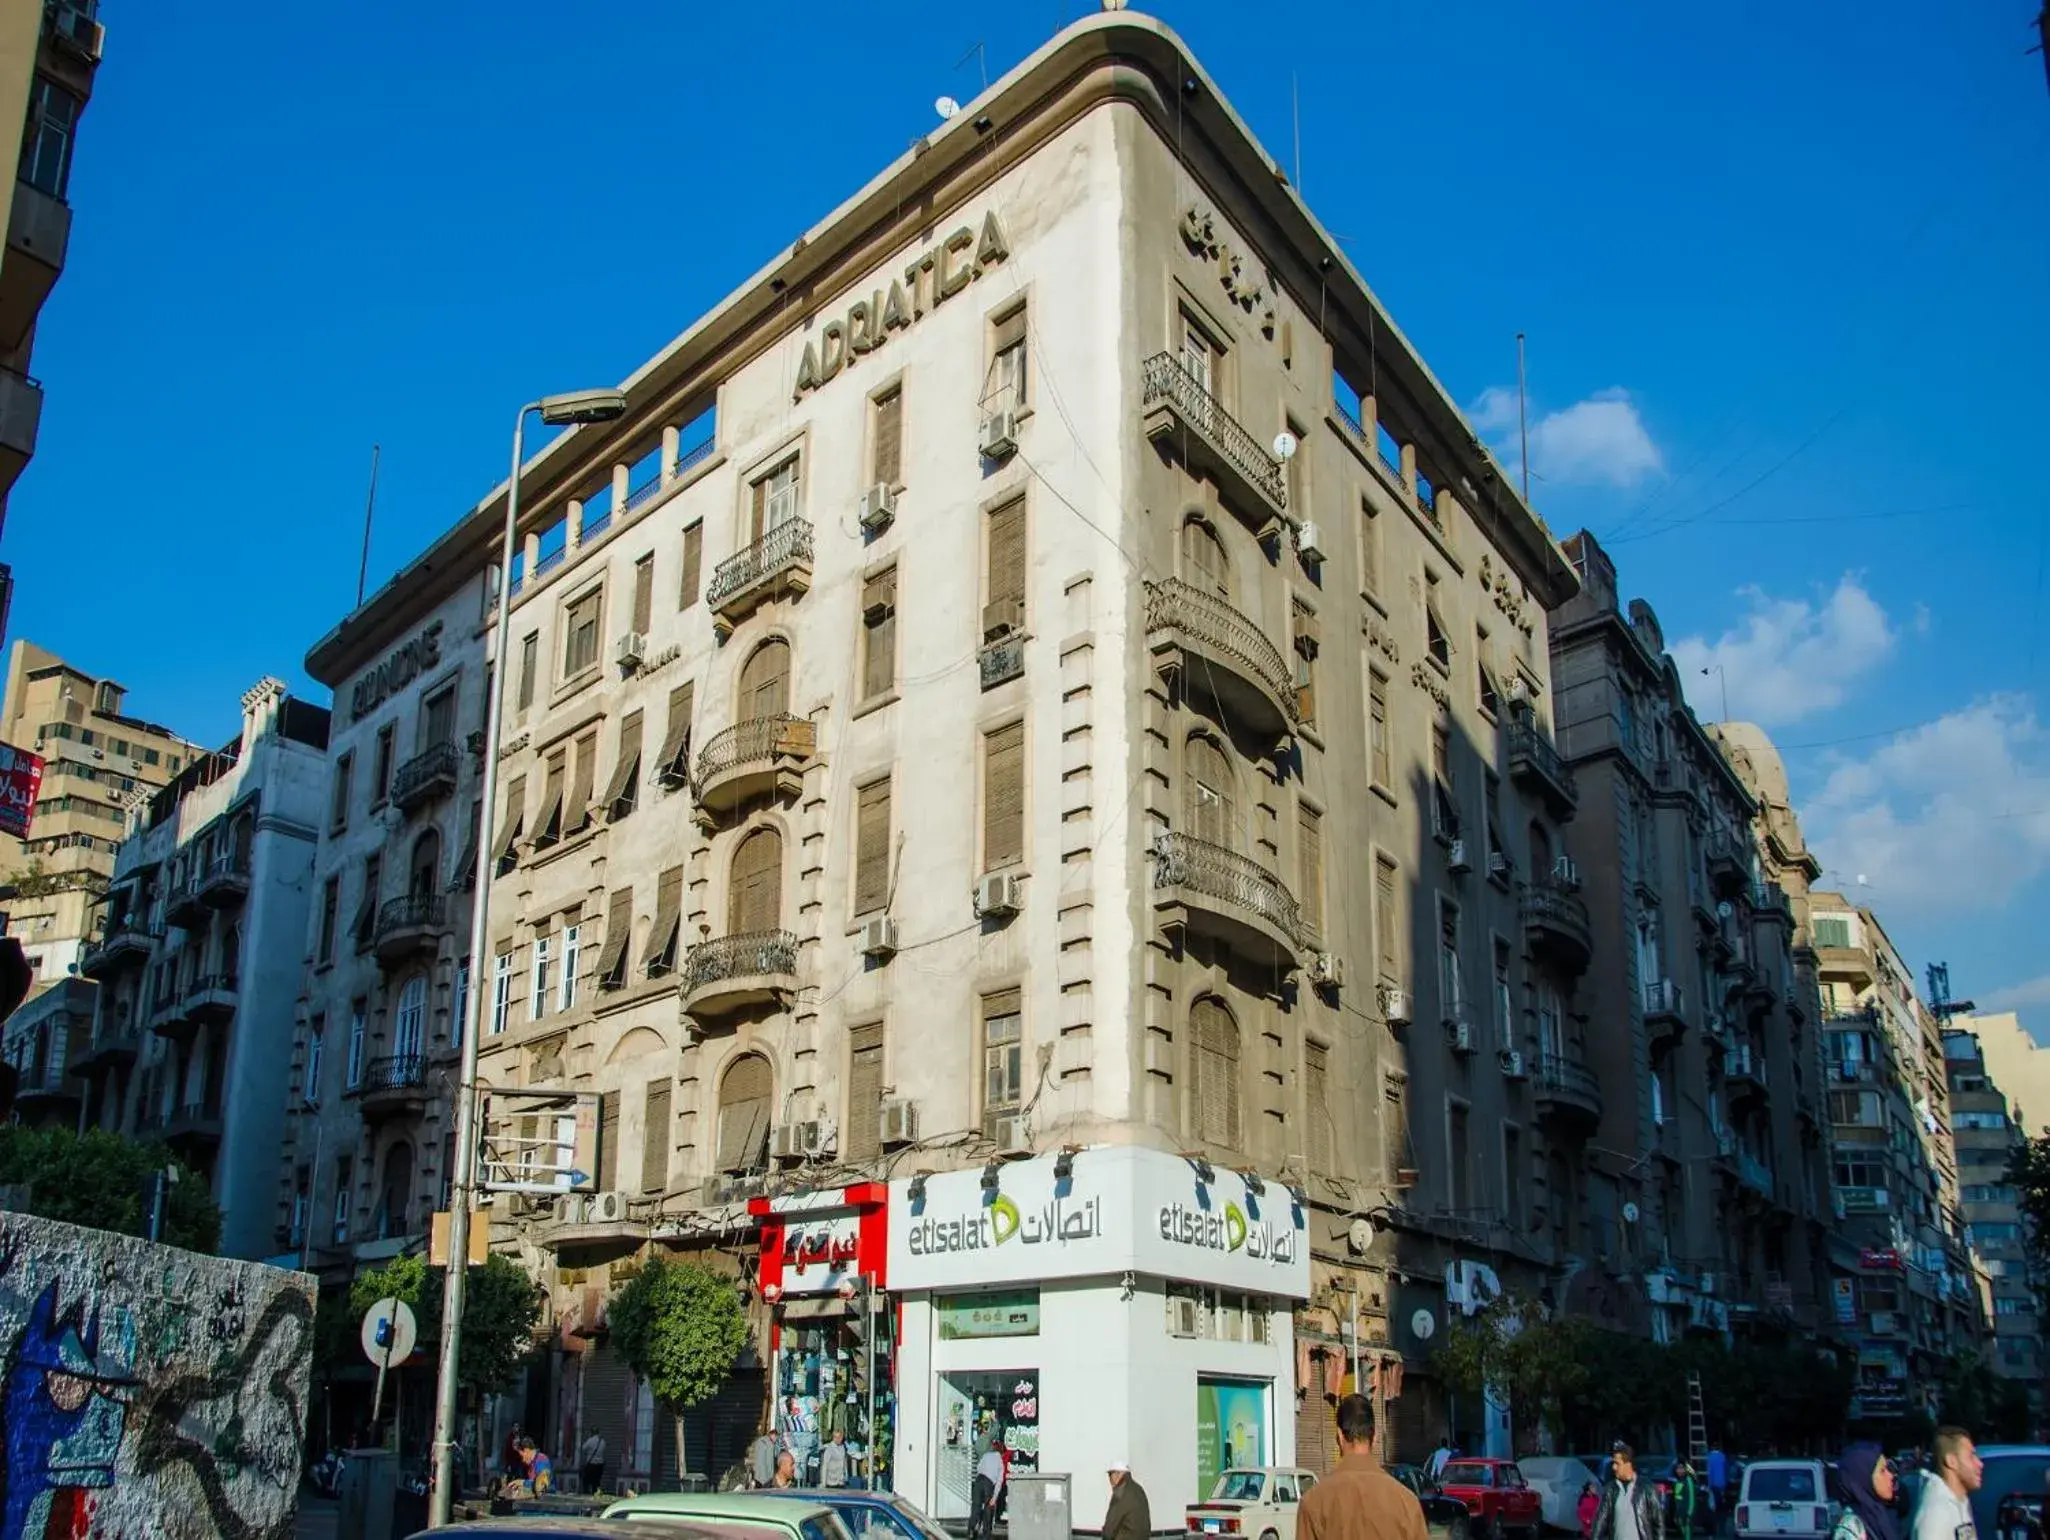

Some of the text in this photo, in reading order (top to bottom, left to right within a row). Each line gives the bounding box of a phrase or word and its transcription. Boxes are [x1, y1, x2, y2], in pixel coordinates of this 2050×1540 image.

[792, 209, 1010, 405] ADRIATICA
[909, 1211, 990, 1255] etisalat
[1020, 1194, 1102, 1247] اتصالات
[1160, 1202, 1225, 1251] etisalat
[1247, 1221, 1296, 1267] اتصالات
